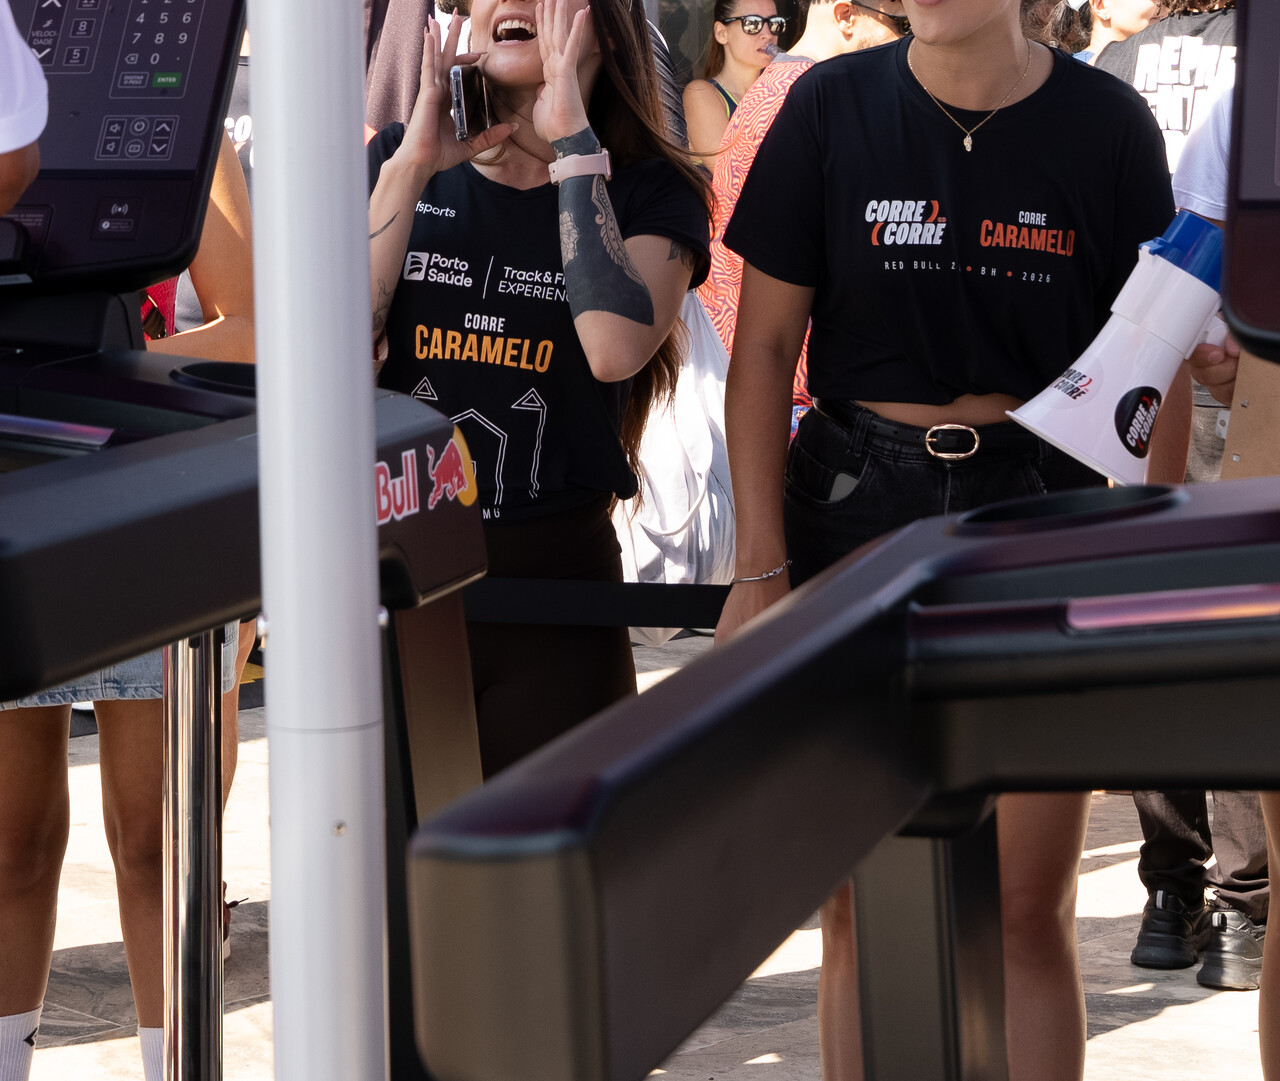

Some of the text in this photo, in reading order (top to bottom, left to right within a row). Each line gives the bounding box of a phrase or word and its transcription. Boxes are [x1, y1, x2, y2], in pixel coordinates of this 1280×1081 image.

[78, 21, 88, 32] 8
[136, 13, 192, 24] 4 5 6
[132, 33, 187, 44] 7 8 9
[72, 49, 81, 60] 5
[150, 53, 160, 64] 0
[1018, 211, 1047, 226] CORRE
[979, 219, 1075, 257] CARAMELO
[430, 253, 469, 271] Porto
[427, 269, 473, 288] Saúde
[884, 261, 904, 270] RED
[913, 260, 941, 270] BULL
[980, 266, 997, 277] BH
[1022, 272, 1052, 283] 2026
[498, 280, 570, 303] EXPERIEN
[464, 312, 505, 333] CORRE
[414, 324, 554, 374] CARAMELO
[375, 449, 420, 526] Bull
